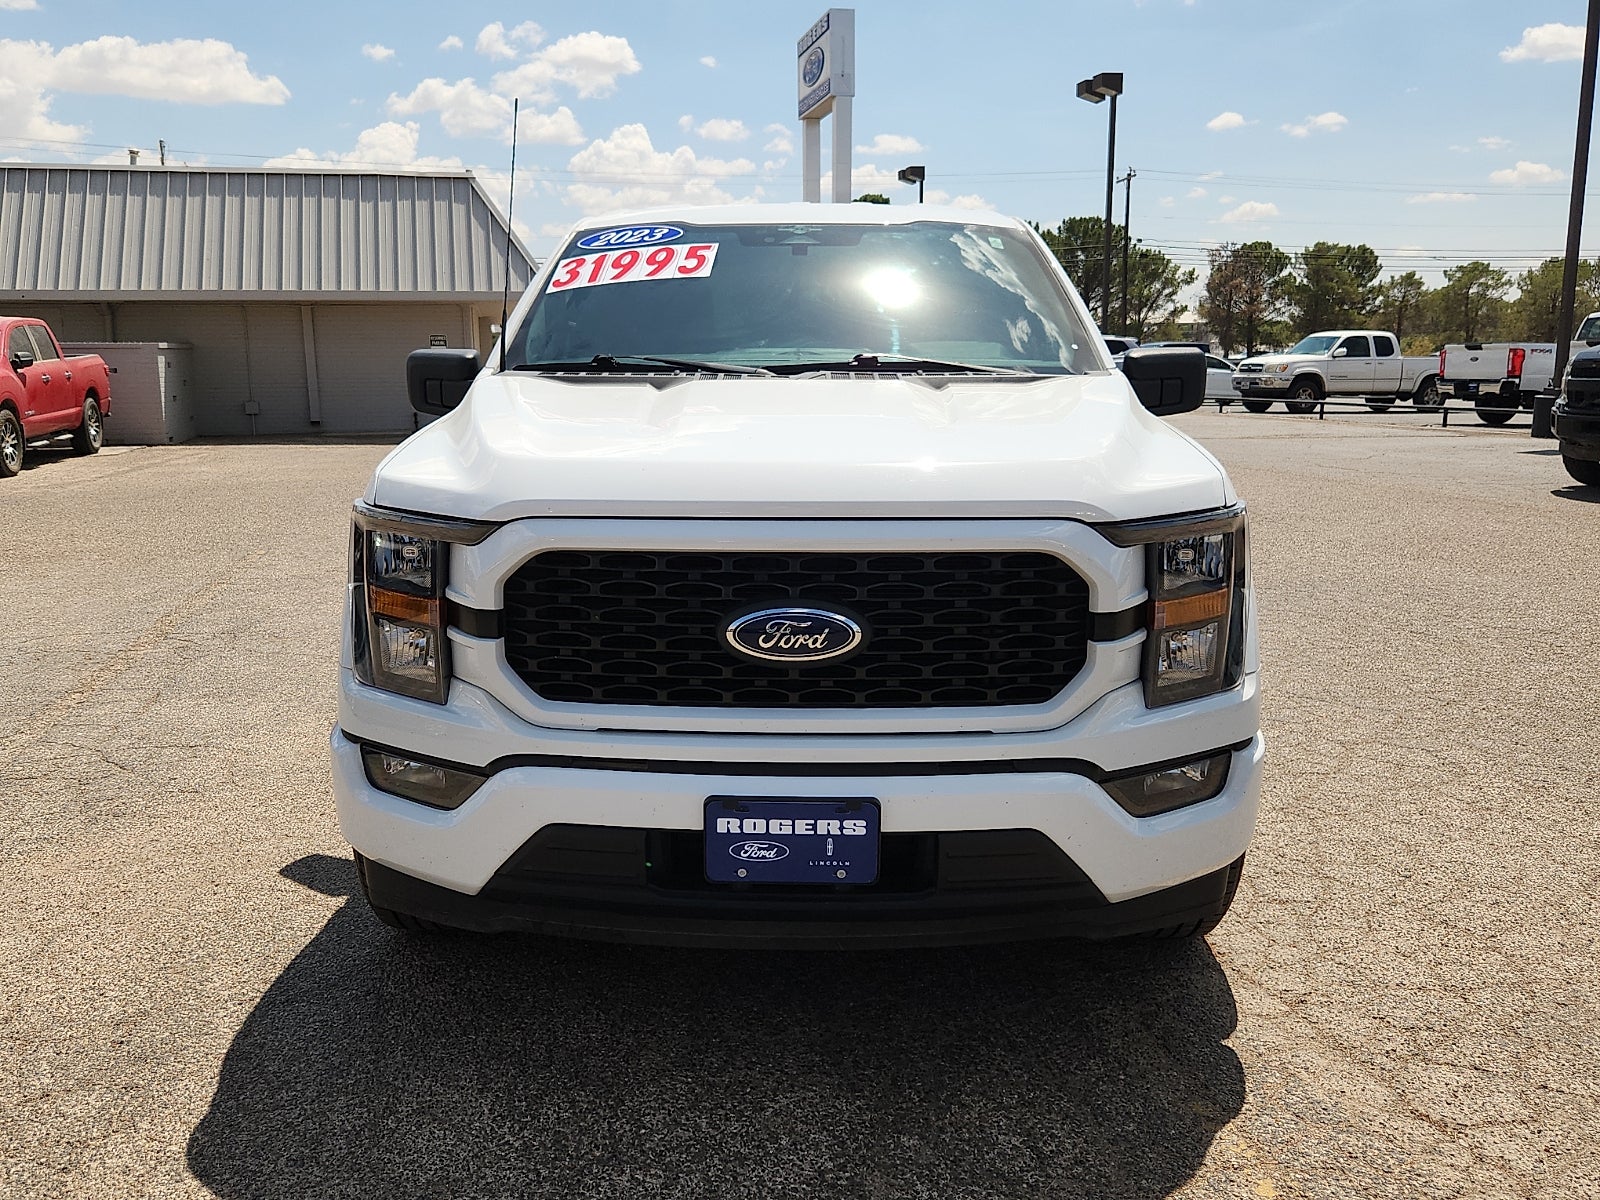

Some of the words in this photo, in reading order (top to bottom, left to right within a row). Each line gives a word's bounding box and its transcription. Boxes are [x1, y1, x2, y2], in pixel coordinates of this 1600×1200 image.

[590, 228, 669, 247] 2023
[552, 245, 712, 288] 31995
[758, 619, 830, 649] Ford
[716, 817, 867, 836] ROGERS
[740, 843, 778, 859] Ford
